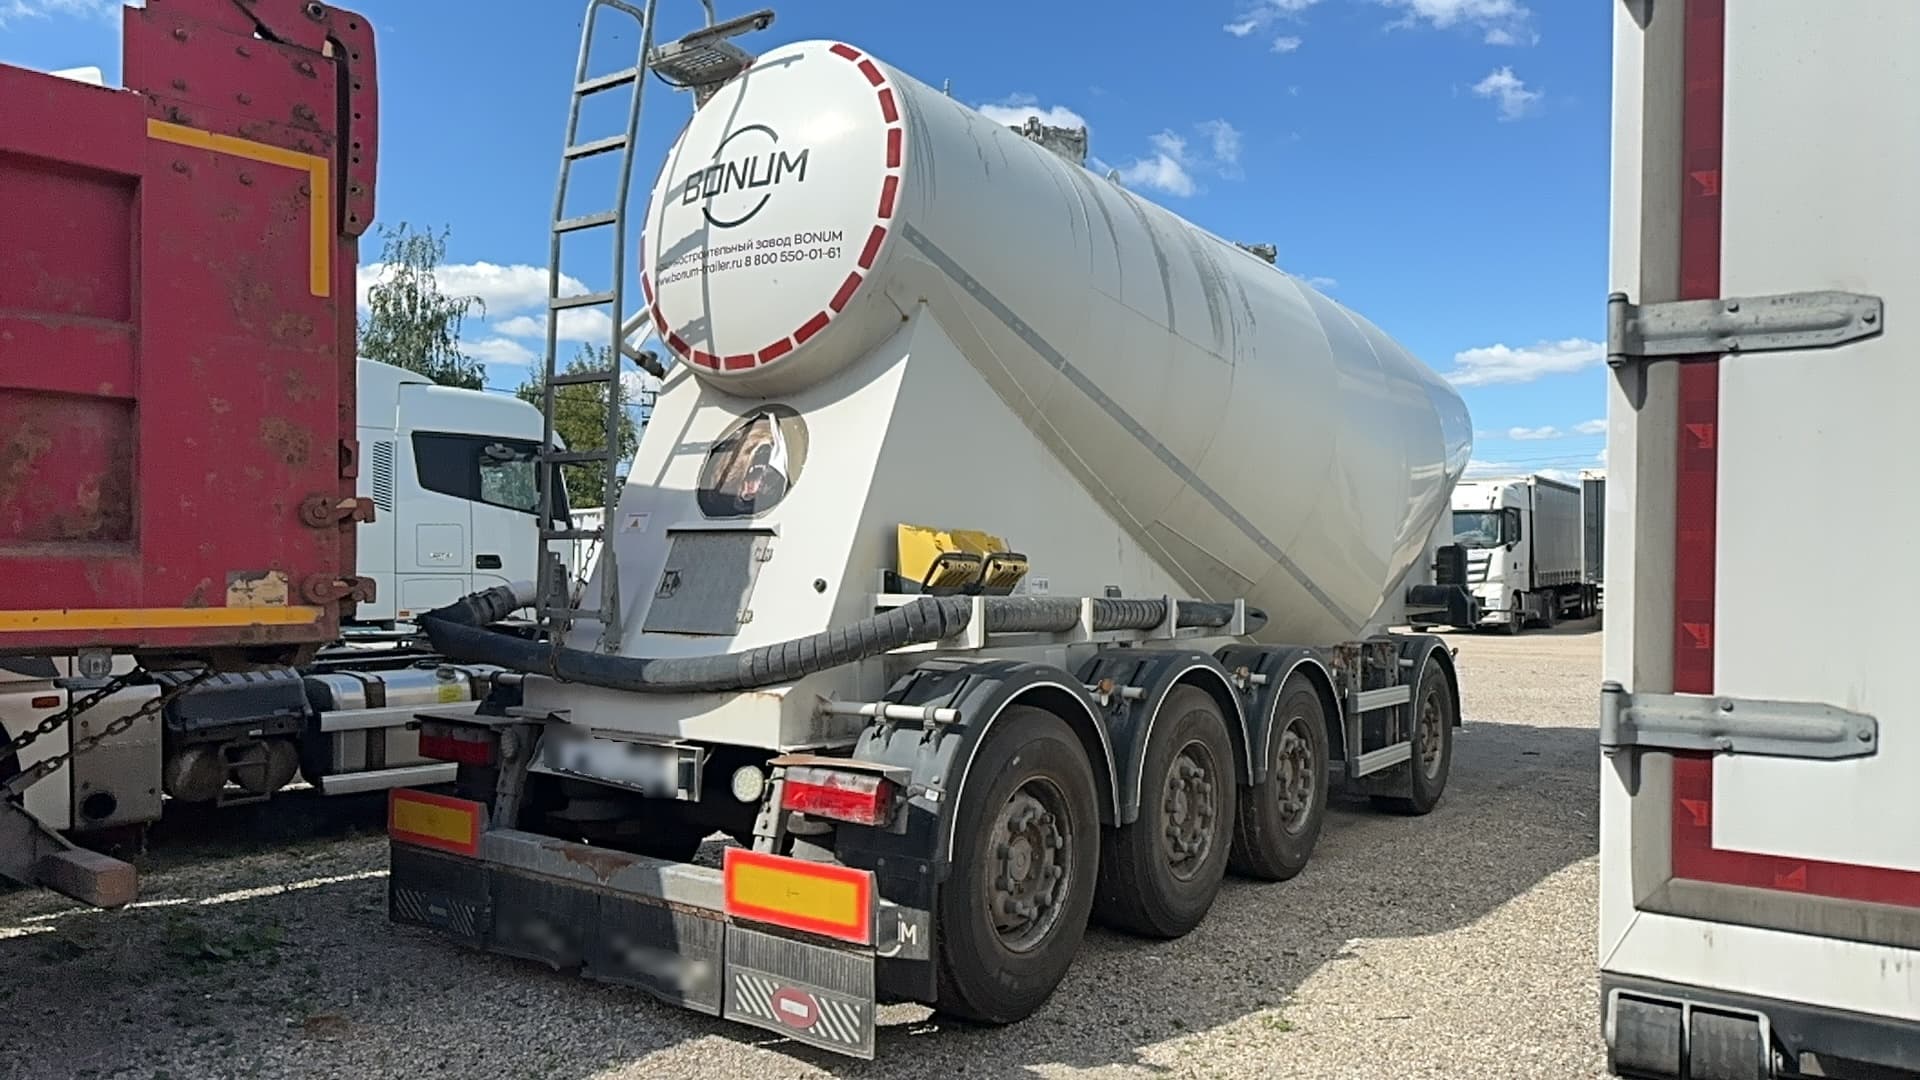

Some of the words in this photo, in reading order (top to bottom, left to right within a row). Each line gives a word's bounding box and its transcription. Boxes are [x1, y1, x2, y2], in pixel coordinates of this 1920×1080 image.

[682, 148, 808, 206] BONUM
[755, 236, 792, 250] завод
[794, 230, 843, 245] BONUM
[744, 255, 752, 267] 8
[754, 252, 778, 266] 800
[780, 246, 841, 263] 550-01-61
